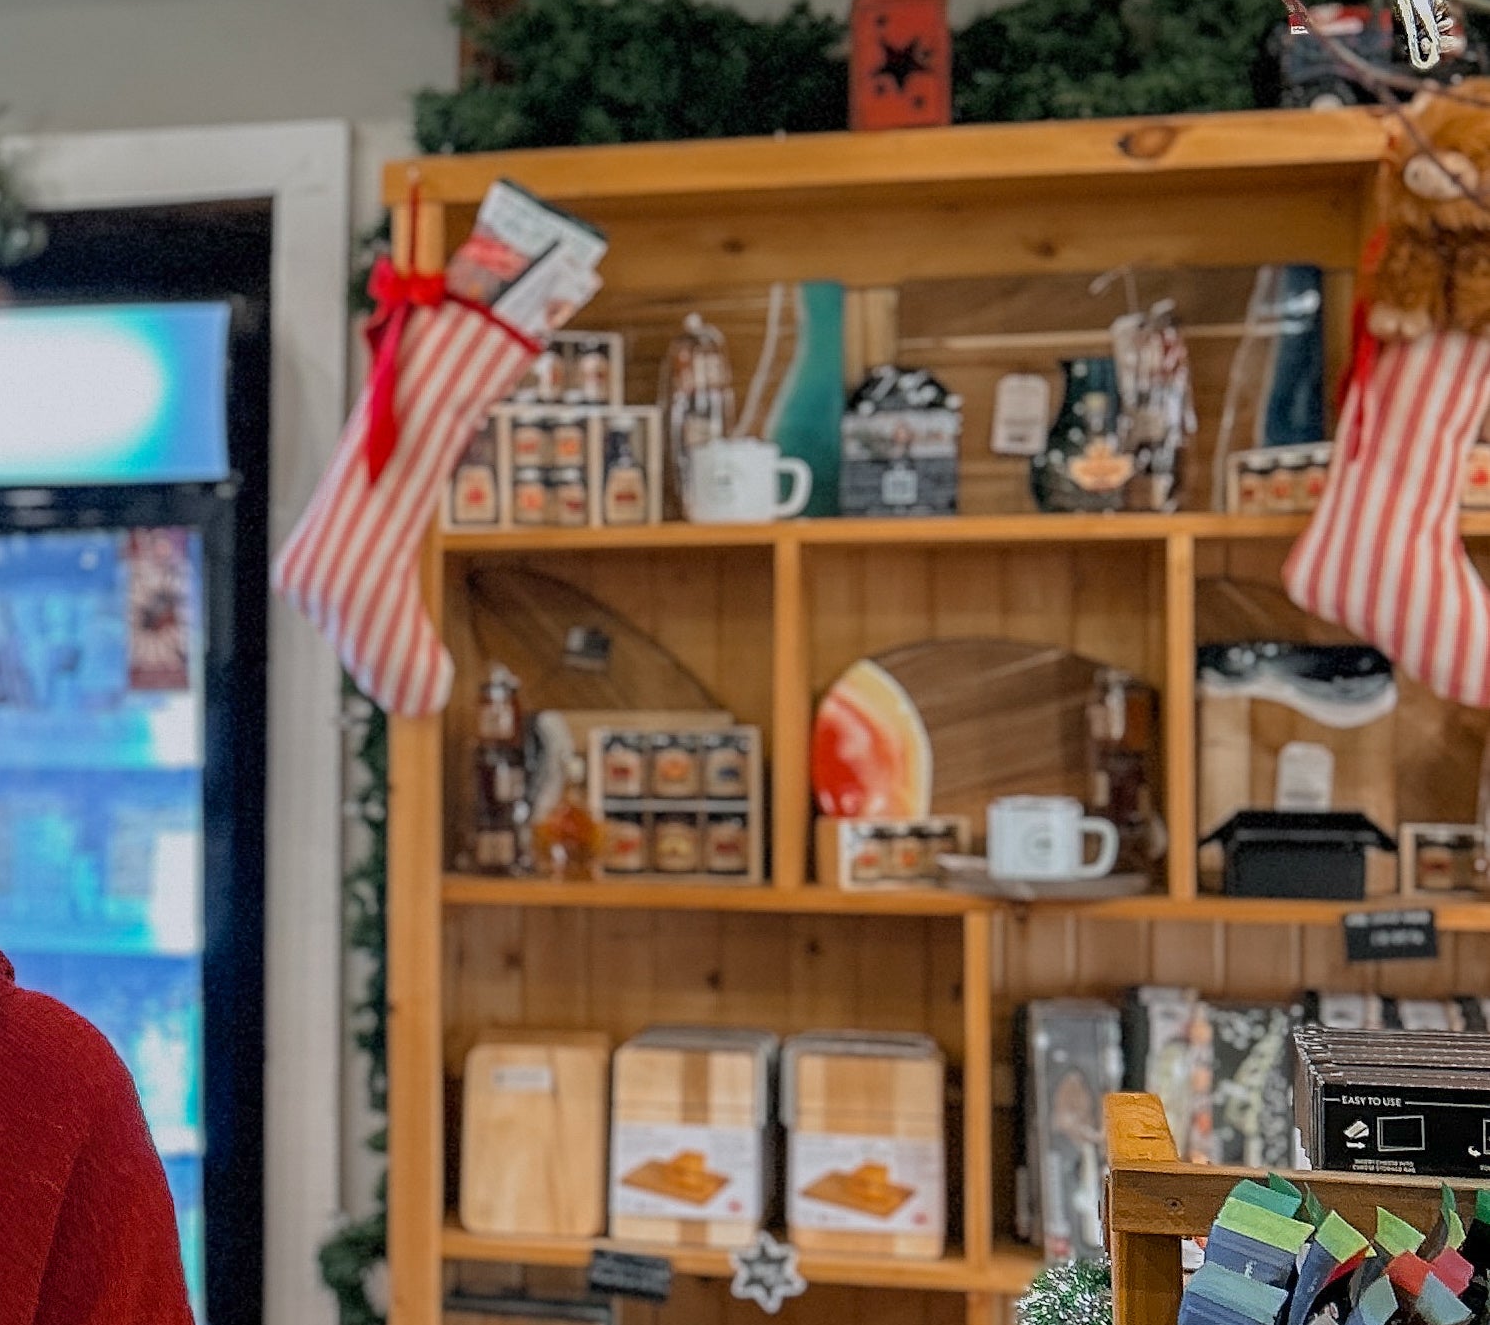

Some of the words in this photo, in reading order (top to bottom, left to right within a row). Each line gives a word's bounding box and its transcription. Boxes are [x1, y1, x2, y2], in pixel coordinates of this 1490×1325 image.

[1341, 1095, 1367, 1106] EASY
[1368, 1097, 1381, 1107] TO
[1382, 1097, 1402, 1108] USE
